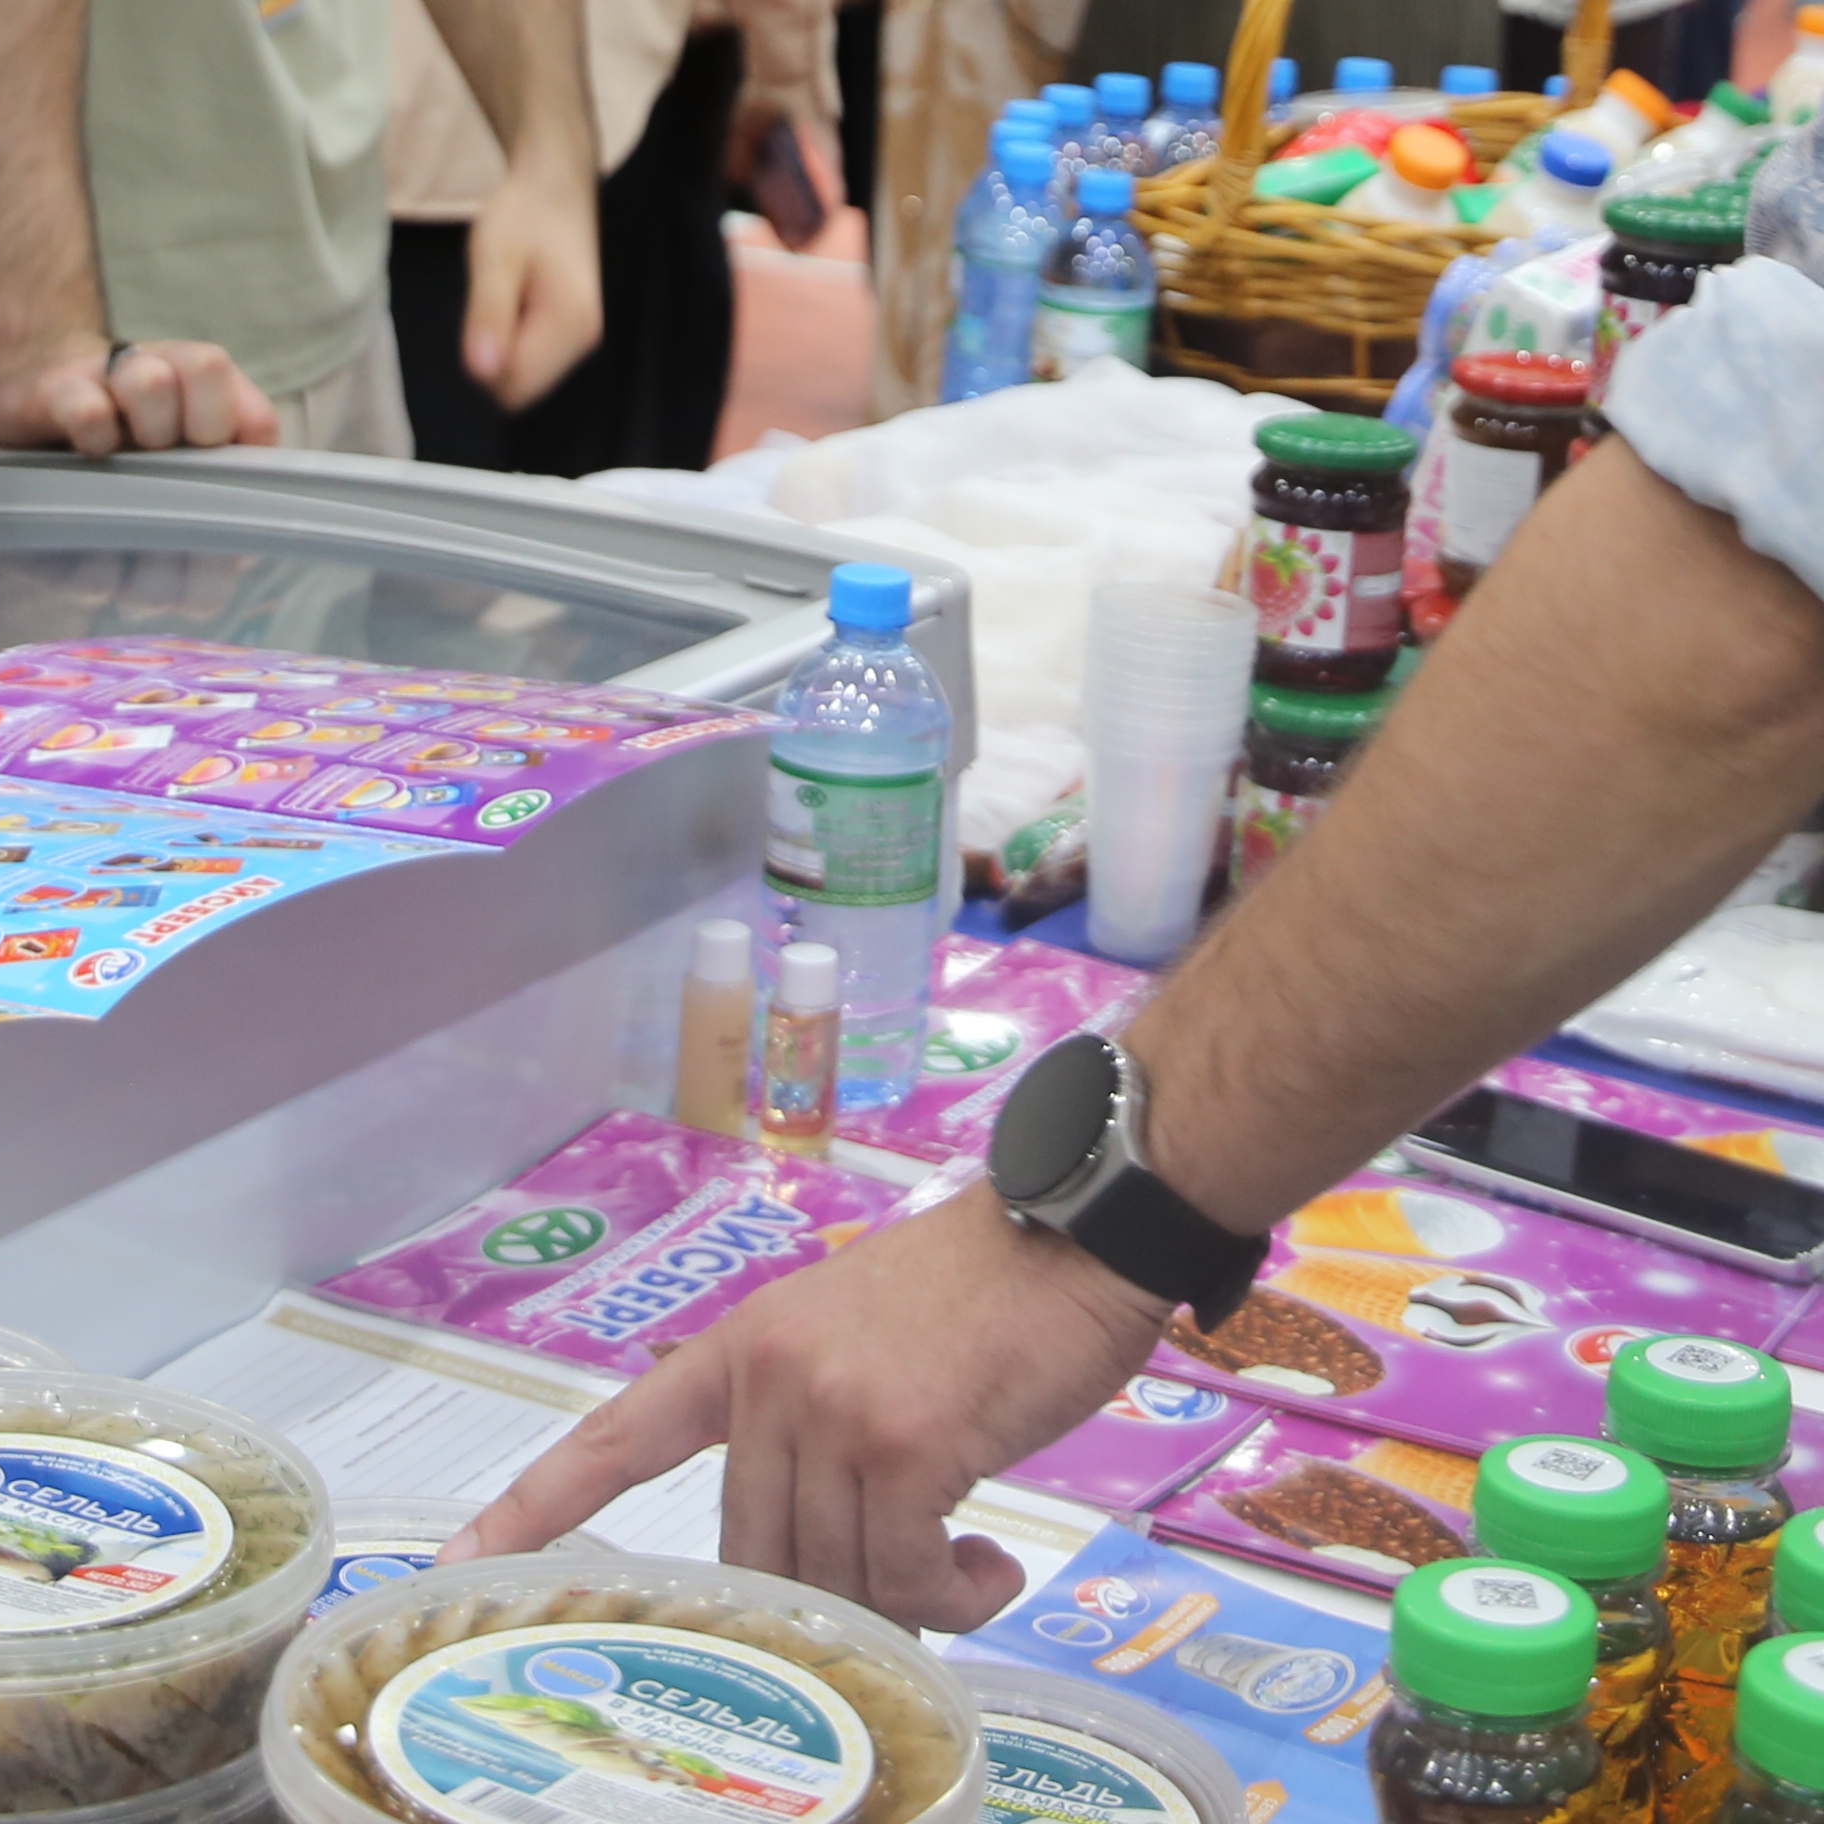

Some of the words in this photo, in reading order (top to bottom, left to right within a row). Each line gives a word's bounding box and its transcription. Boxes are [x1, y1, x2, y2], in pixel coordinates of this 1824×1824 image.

[124, 874, 284, 945] АЙСБЕРГ
[563, 1195, 812, 1342] АЙСБЕРГ
[6, 1478, 162, 1533] СЕЛЬДЬ
[14, 1501, 105, 1535] МАСЛЕ
[607, 1697, 628, 1710] В
[632, 1703, 732, 1746] МАСЛЕ
[628, 1678, 804, 1748] СЕЛЬДЬ
[985, 1760, 1125, 1808] ЕЛЬДЬ
[1032, 1794, 1113, 1822] МАСЛЕ
